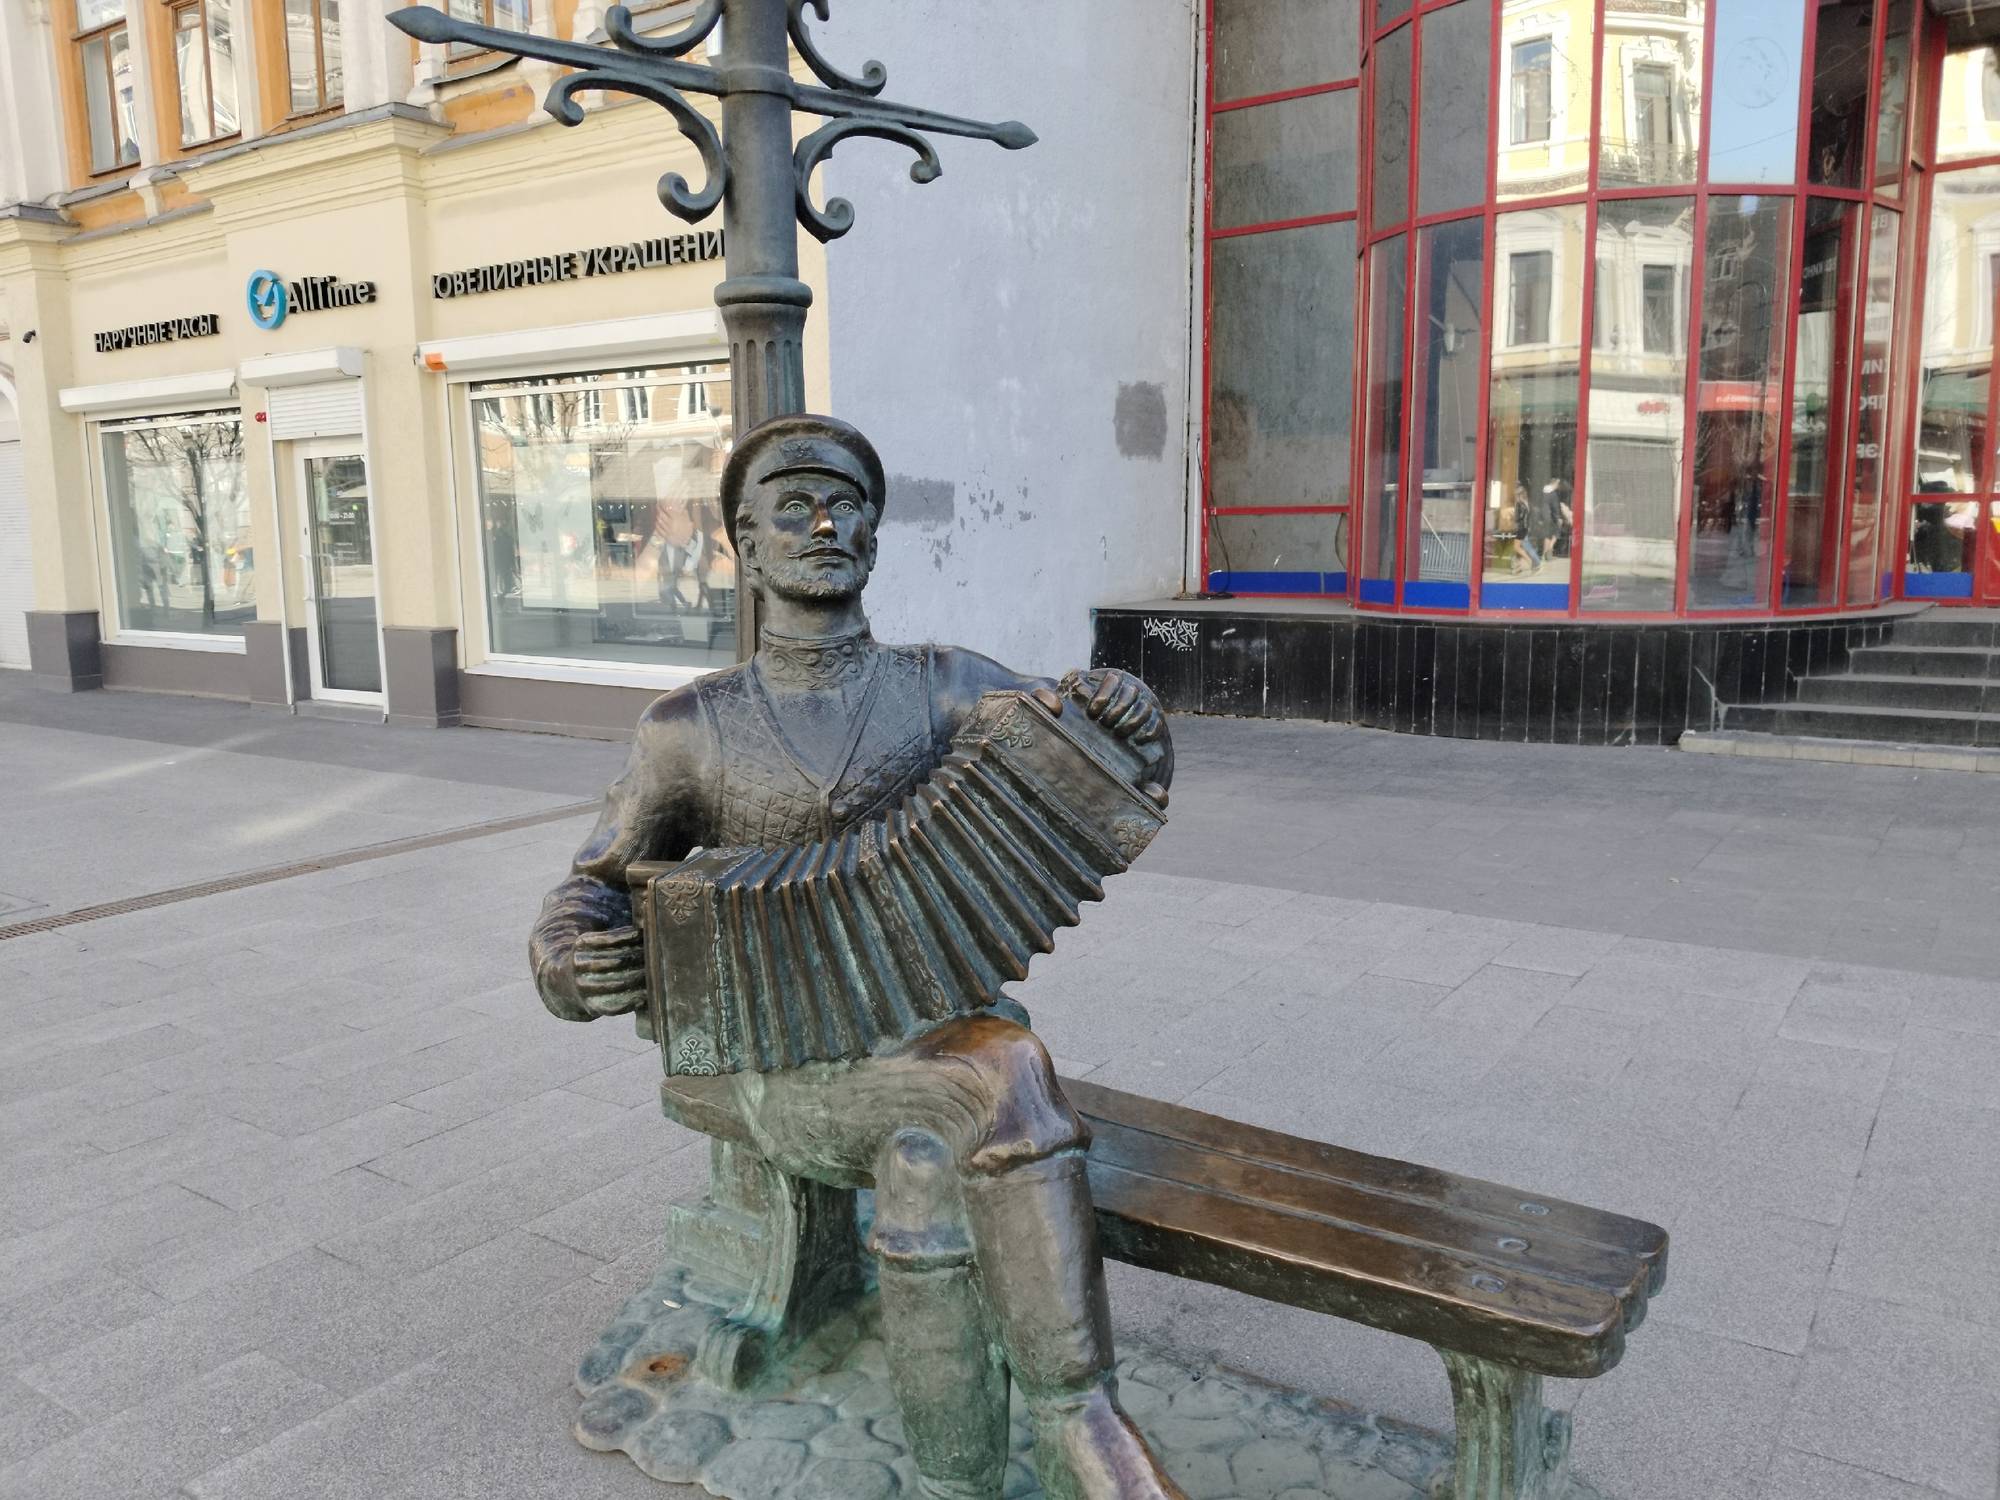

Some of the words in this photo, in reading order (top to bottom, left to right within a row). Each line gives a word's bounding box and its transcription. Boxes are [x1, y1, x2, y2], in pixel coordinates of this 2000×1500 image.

[432, 252, 574, 299] ЮВЕЛИРНЫЕ
[576, 228, 725, 278] УКРАШЕНИ
[286, 275, 375, 313] AllTime
[94, 321, 169, 352] НАРУЧНЫЕ
[168, 313, 219, 340] ЧАСЫ
